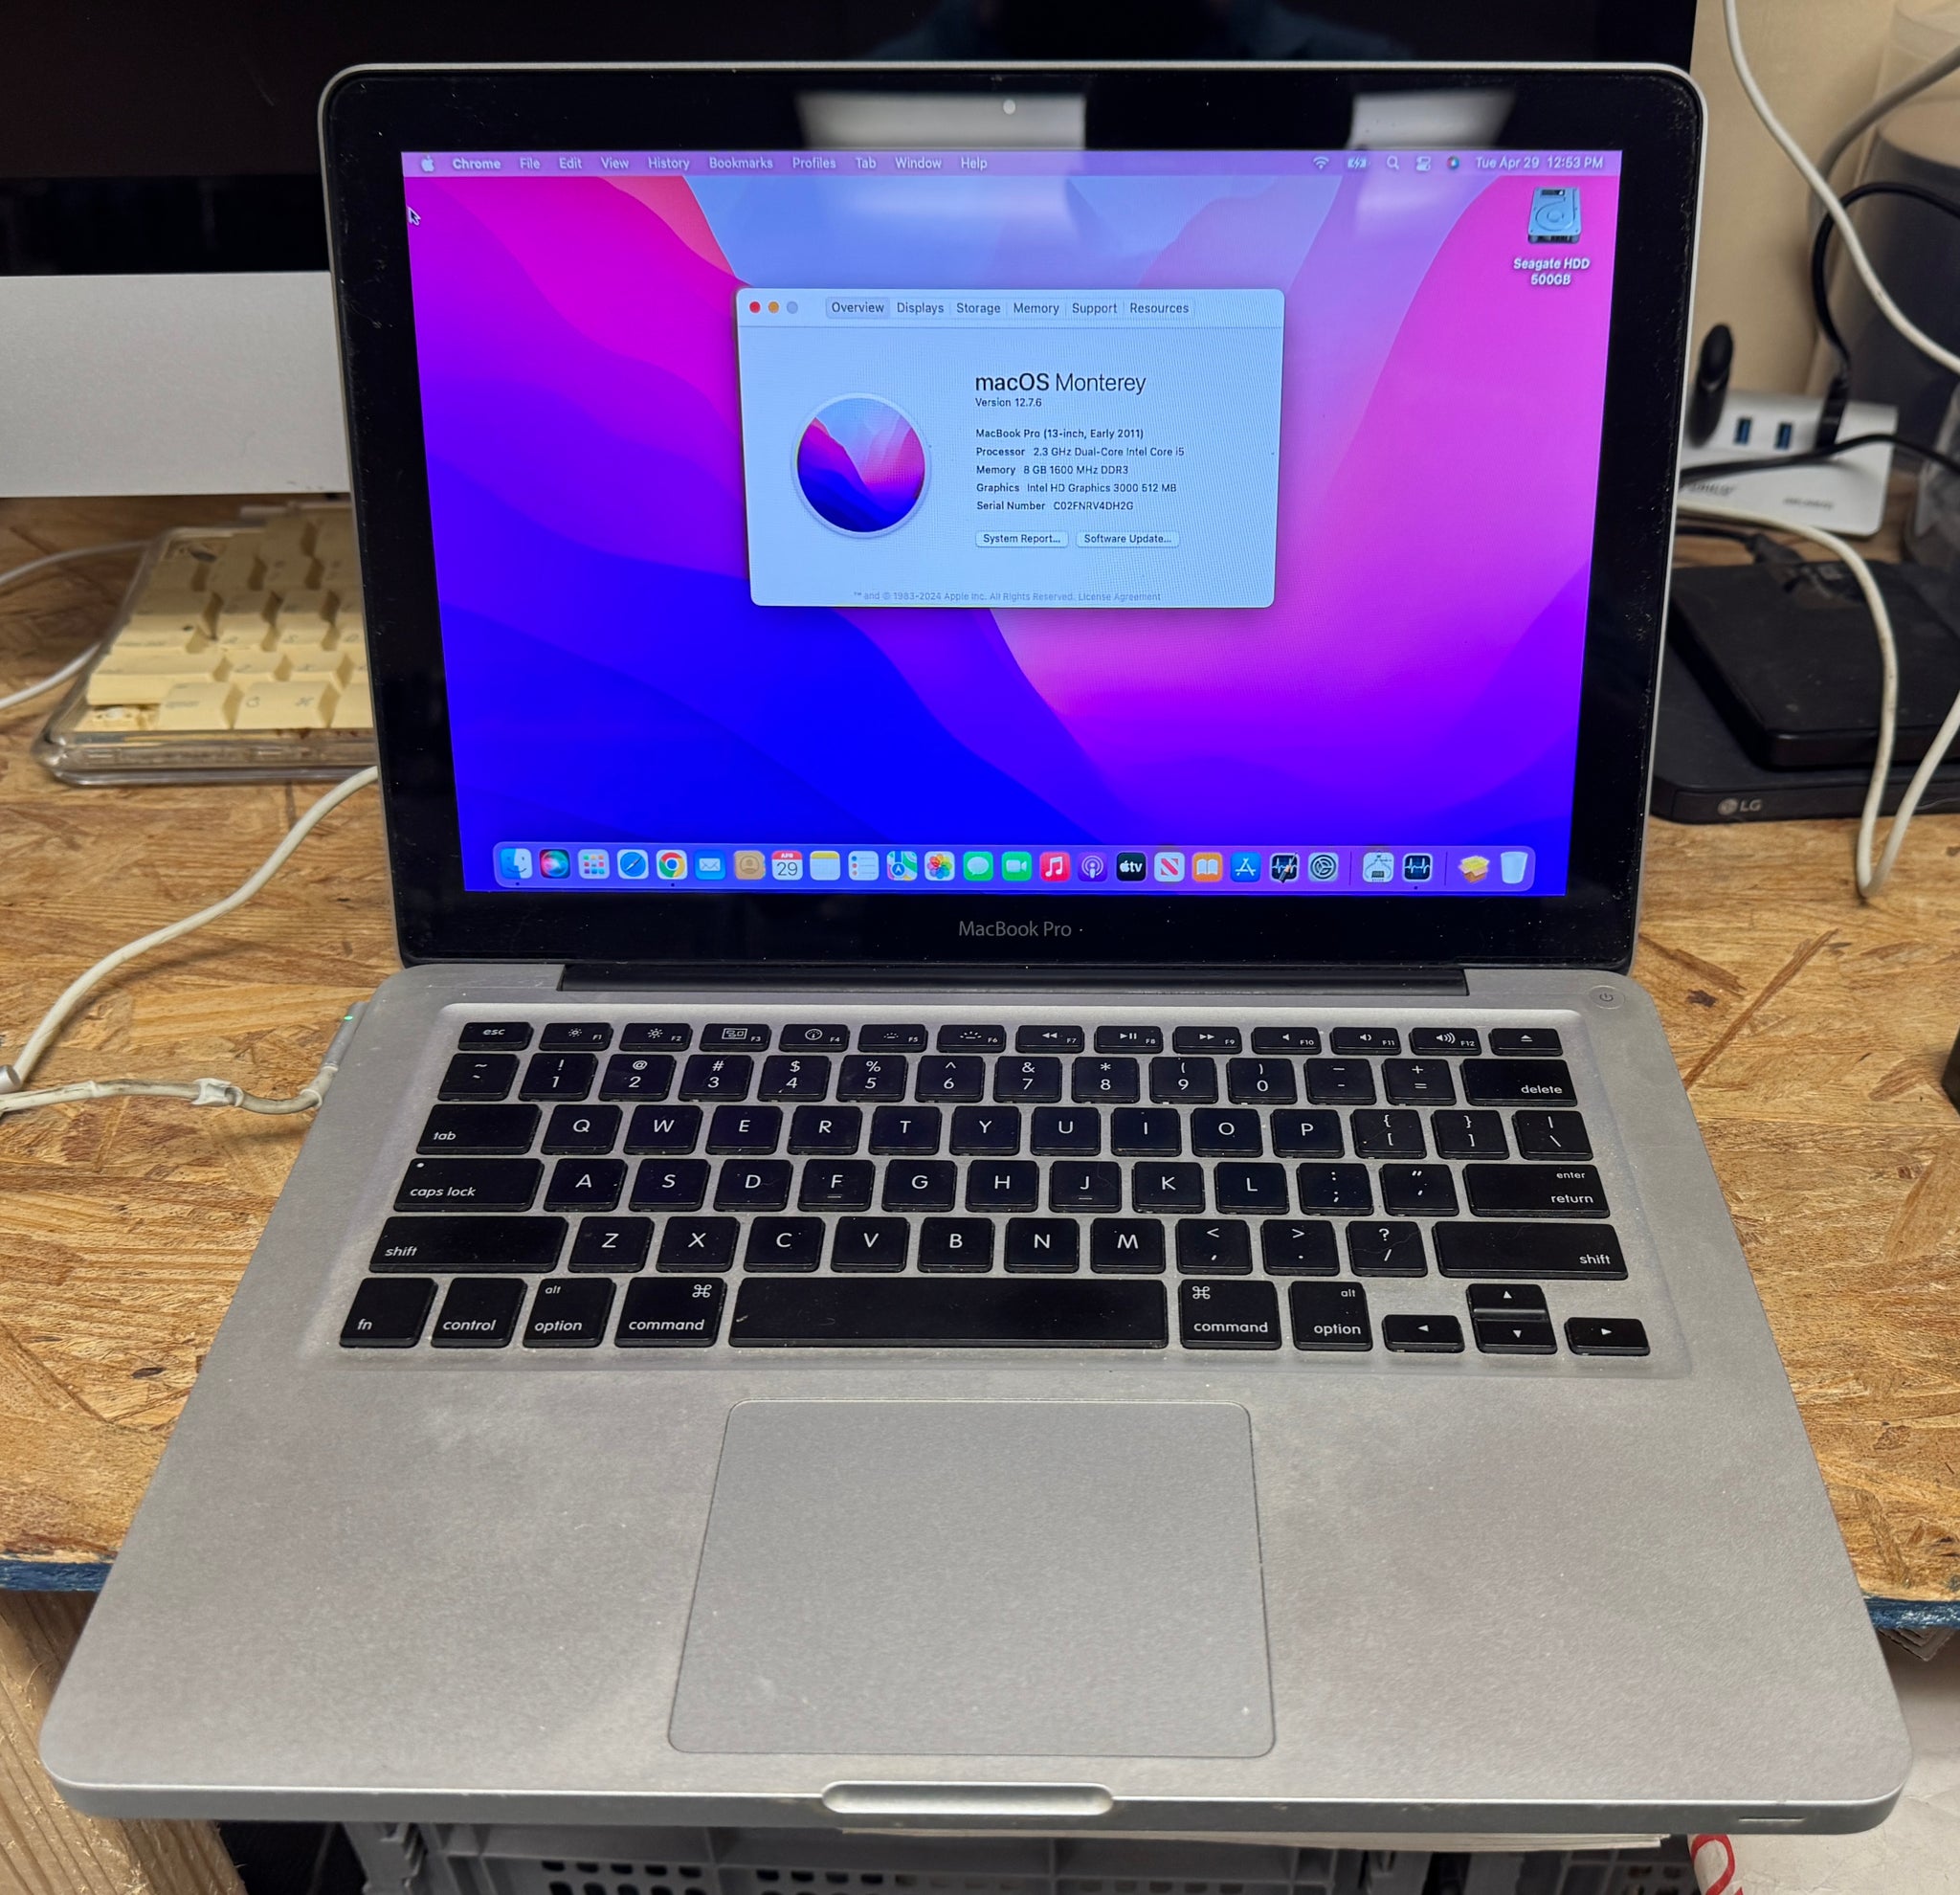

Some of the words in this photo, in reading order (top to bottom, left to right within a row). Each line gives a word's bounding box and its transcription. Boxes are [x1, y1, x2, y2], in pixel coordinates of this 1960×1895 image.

[452, 157, 501, 170] Chrome
[520, 157, 541, 170] File
[559, 157, 582, 170] Edit
[600, 157, 630, 170] View
[648, 157, 690, 171] History
[709, 157, 773, 170] Bookmarks
[792, 157, 835, 170] Profiles
[856, 157, 877, 170] Tab
[895, 157, 942, 170] Window
[960, 157, 988, 171] Help
[1476, 157, 1497, 168] Tue
[1500, 157, 1520, 170] Apr
[1523, 157, 1539, 168] 29
[1584, 157, 1604, 168] PM
[1513, 257, 1561, 272] Seagate
[1564, 257, 1590, 269] HDD
[1530, 274, 1571, 285] 500GB
[831, 302, 885, 314] Overview
[897, 302, 945, 316] Displays
[956, 302, 1000, 316] Storage
[1013, 302, 1059, 316] Memory
[1072, 302, 1118, 316] Support
[1129, 302, 1189, 314] Resources
[975, 372, 1050, 391] macOS
[1055, 372, 1147, 395] Monterey
[975, 397, 1012, 407] Version
[1014, 397, 1042, 407] 12.7.6
[976, 429, 1021, 438] MacBook
[1024, 430, 1040, 438] Pro
[1043, 429, 1087, 439] (13-inch,
[1090, 429, 1115, 439] Early
[1117, 429, 1144, 439] 2011)
[976, 447, 1025, 457] Processor
[1034, 447, 1048, 457] 2.3
[1051, 447, 1072, 457] GHz
[1075, 447, 1123, 457] Dual-Core
[1126, 447, 1147, 457] Intel
[1150, 447, 1172, 457] Core
[1175, 447, 1184, 457] i5
[976, 466, 1015, 476] Memory
[1023, 466, 1030, 475] 8
[1033, 466, 1047, 475] GB
[1050, 466, 1073, 475] 1600
[1076, 466, 1098, 475] MHz
[1101, 466, 1128, 475] DDR3
[976, 483, 1019, 494] Graphics
[1027, 483, 1048, 492] Intel
[1051, 483, 1065, 492] HD
[1068, 483, 1110, 494] Graphics
[1113, 483, 1139, 492] 3000
[1142, 483, 1158, 492] 512
[1161, 483, 1176, 492] MB
[977, 502, 1004, 510] Serial
[1007, 502, 1045, 510] Number
[983, 534, 1018, 545] System
[1084, 534, 1126, 544] Software
[944, 591, 969, 602] Apple
[1003, 591, 1030, 603] Rights
[1079, 592, 1111, 601] License
[1739, 799, 1762, 812] LG
[777, 861, 798, 876] 29
[958, 920, 1038, 938] MacBook
[1043, 920, 1073, 938] Pro
[557, 1059, 565, 1071] !
[632, 1059, 648, 1071] @
[712, 1059, 724, 1072] #
[790, 1059, 801, 1073] $
[865, 1060, 881, 1073] %
[1021, 1061, 1036, 1073] &
[552, 1076, 560, 1088] 1
[628, 1076, 641, 1088] 2
[707, 1076, 720, 1088] 3
[786, 1077, 798, 1089] 4
[864, 1077, 877, 1089] 5
[943, 1077, 955, 1090] 6
[1022, 1078, 1034, 1090] 7
[1100, 1079, 1111, 1091] 8
[1177, 1079, 1190, 1091] 9
[1257, 1080, 1269, 1092] 0
[1521, 1084, 1563, 1094] delete
[572, 1119, 590, 1133] Q
[654, 1119, 675, 1133] W
[738, 1119, 751, 1133] E
[818, 1120, 833, 1134] R
[900, 1120, 912, 1134] T
[979, 1120, 992, 1134] Y
[1058, 1120, 1074, 1134] U
[1144, 1122, 1148, 1135] I
[1217, 1122, 1236, 1136] O
[1301, 1123, 1314, 1137] P
[433, 1130, 457, 1141] tab
[575, 1173, 592, 1189] A
[661, 1173, 676, 1189] S
[745, 1174, 762, 1189] D
[831, 1174, 844, 1189] F
[911, 1174, 928, 1190] G
[994, 1174, 1011, 1190] H
[1080, 1175, 1090, 1191] J
[1161, 1175, 1176, 1191] K
[1246, 1177, 1258, 1192] L
[410, 1188, 444, 1198] caps
[446, 1186, 477, 1197] lock
[1550, 1193, 1594, 1204] return
[601, 1233, 619, 1248] Z
[687, 1232, 706, 1248] X
[775, 1232, 792, 1248] C
[863, 1232, 880, 1248] V
[949, 1233, 963, 1249] B
[1378, 1228, 1390, 1241] ?
[1034, 1234, 1051, 1249] N
[1117, 1234, 1139, 1249] M
[385, 1245, 418, 1257] shift
[1579, 1254, 1611, 1264] shift
[545, 1284, 562, 1295] alt
[1340, 1288, 1356, 1298] alt
[357, 1318, 373, 1330] fn
[442, 1319, 497, 1331] control
[534, 1320, 583, 1334] option
[628, 1319, 705, 1330] command
[1193, 1321, 1269, 1333] command
[1313, 1323, 1362, 1337] option
